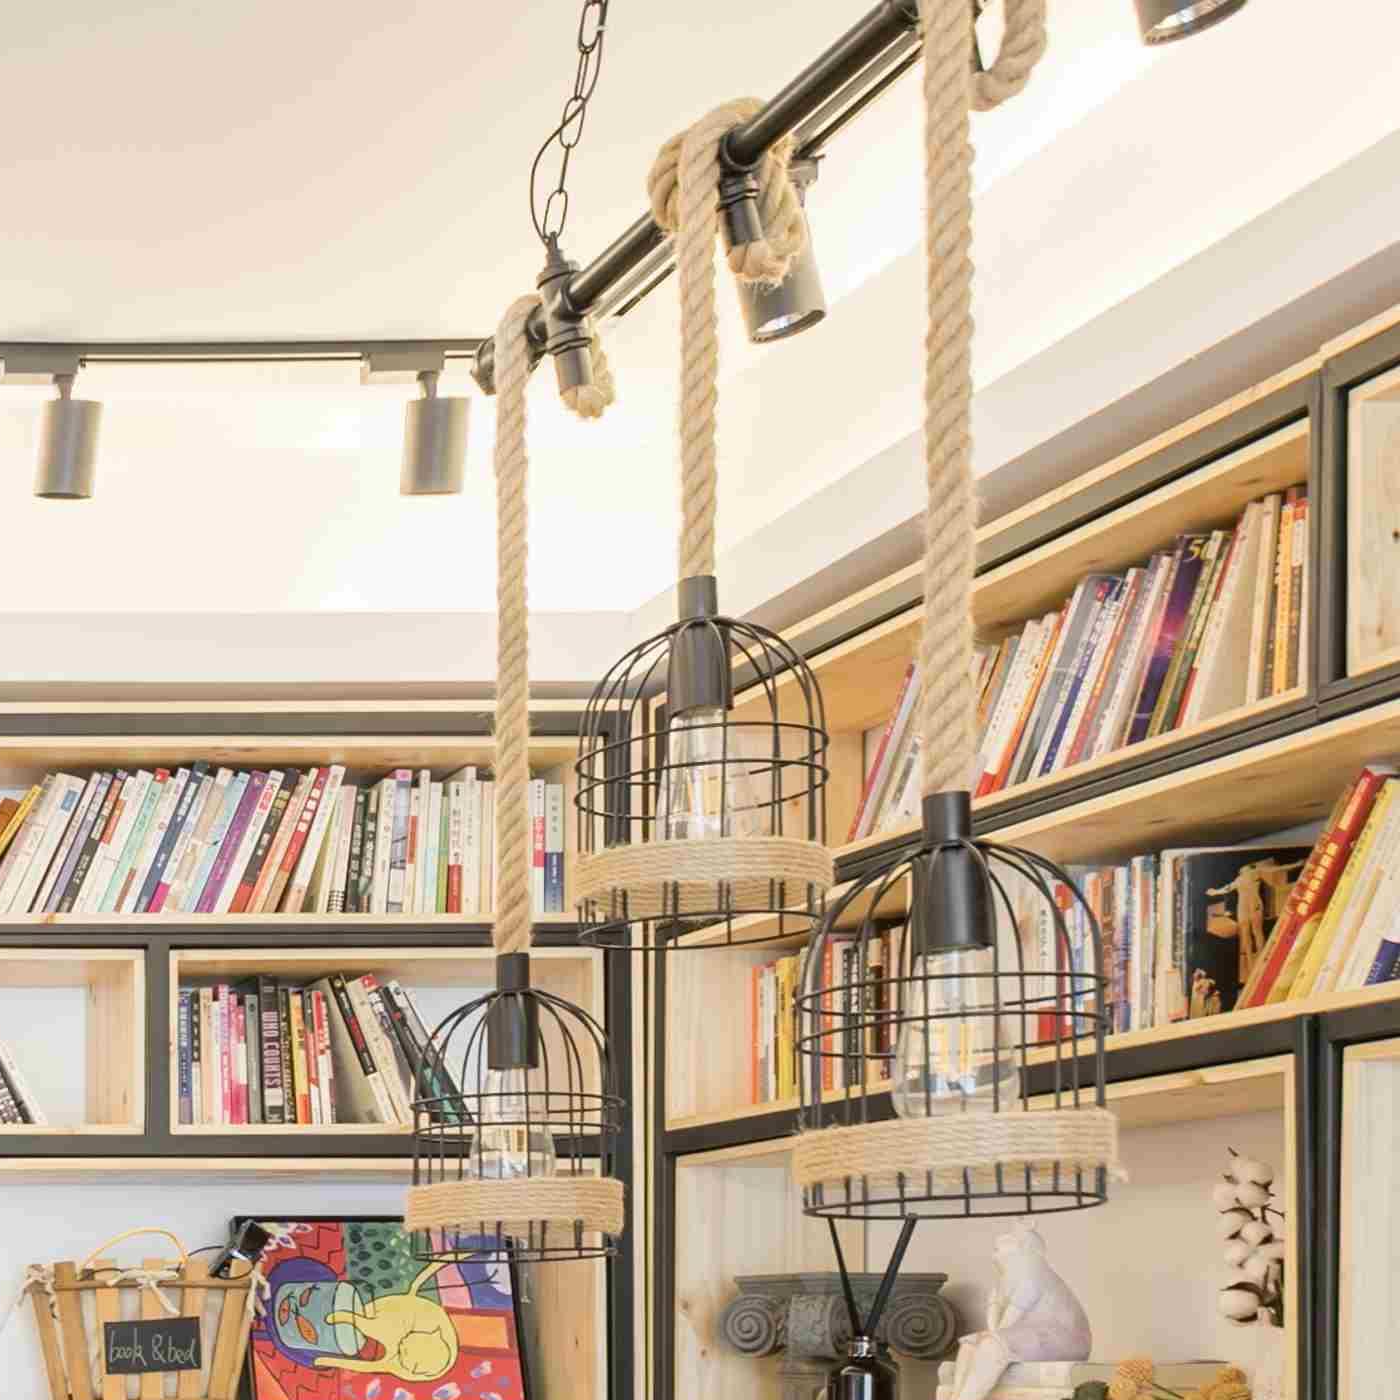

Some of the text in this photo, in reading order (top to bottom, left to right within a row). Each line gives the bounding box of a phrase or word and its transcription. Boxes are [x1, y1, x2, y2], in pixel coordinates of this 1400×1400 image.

[262, 1011, 279, 1037] WHO
[108, 1328, 198, 1367] book & bed
